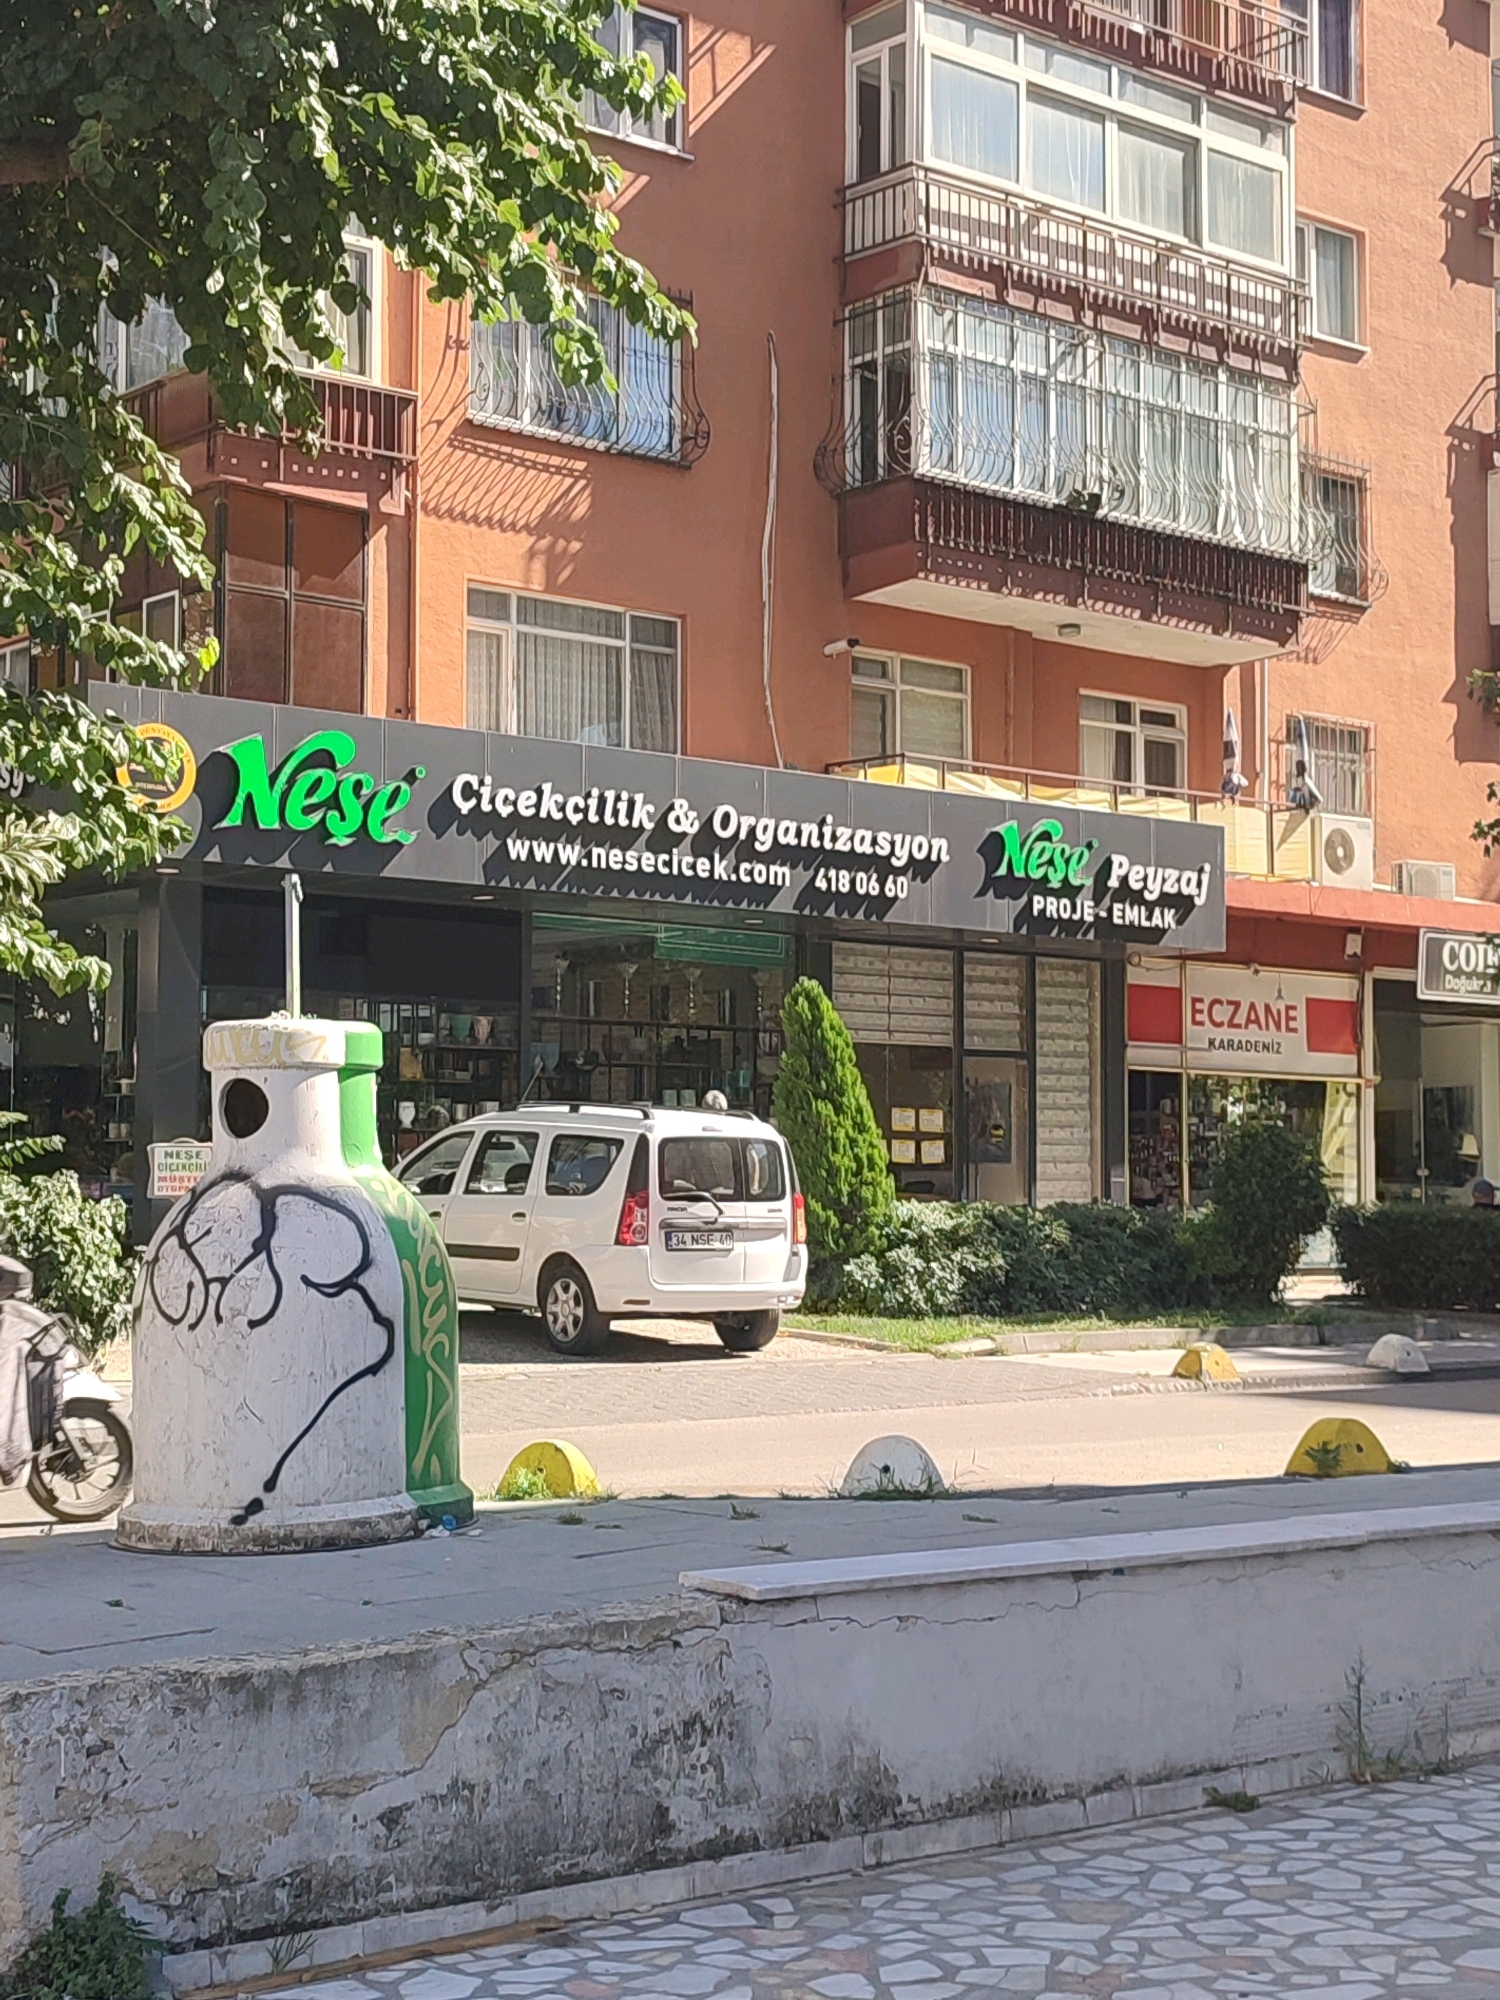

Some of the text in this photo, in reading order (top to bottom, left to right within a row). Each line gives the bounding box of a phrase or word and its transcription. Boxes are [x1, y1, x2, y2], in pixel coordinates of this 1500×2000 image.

[452, 773, 951, 867] Çiçekçilik & Organizasyon
[506, 837, 909, 900] www.nesecicek.com 418 06 60
[1107, 853, 1213, 906] Peyzaj
[1032, 894, 1096, 922] PROJE
[1112, 902, 1177, 930] EMLAK
[1190, 995, 1299, 1034] ECZANE
[1207, 1036, 1283, 1056] KARADENİZ
[163, 1150, 203, 1161] NEŞE
[673, 1233, 687, 1247] 34
[690, 1233, 715, 1247] NSE
